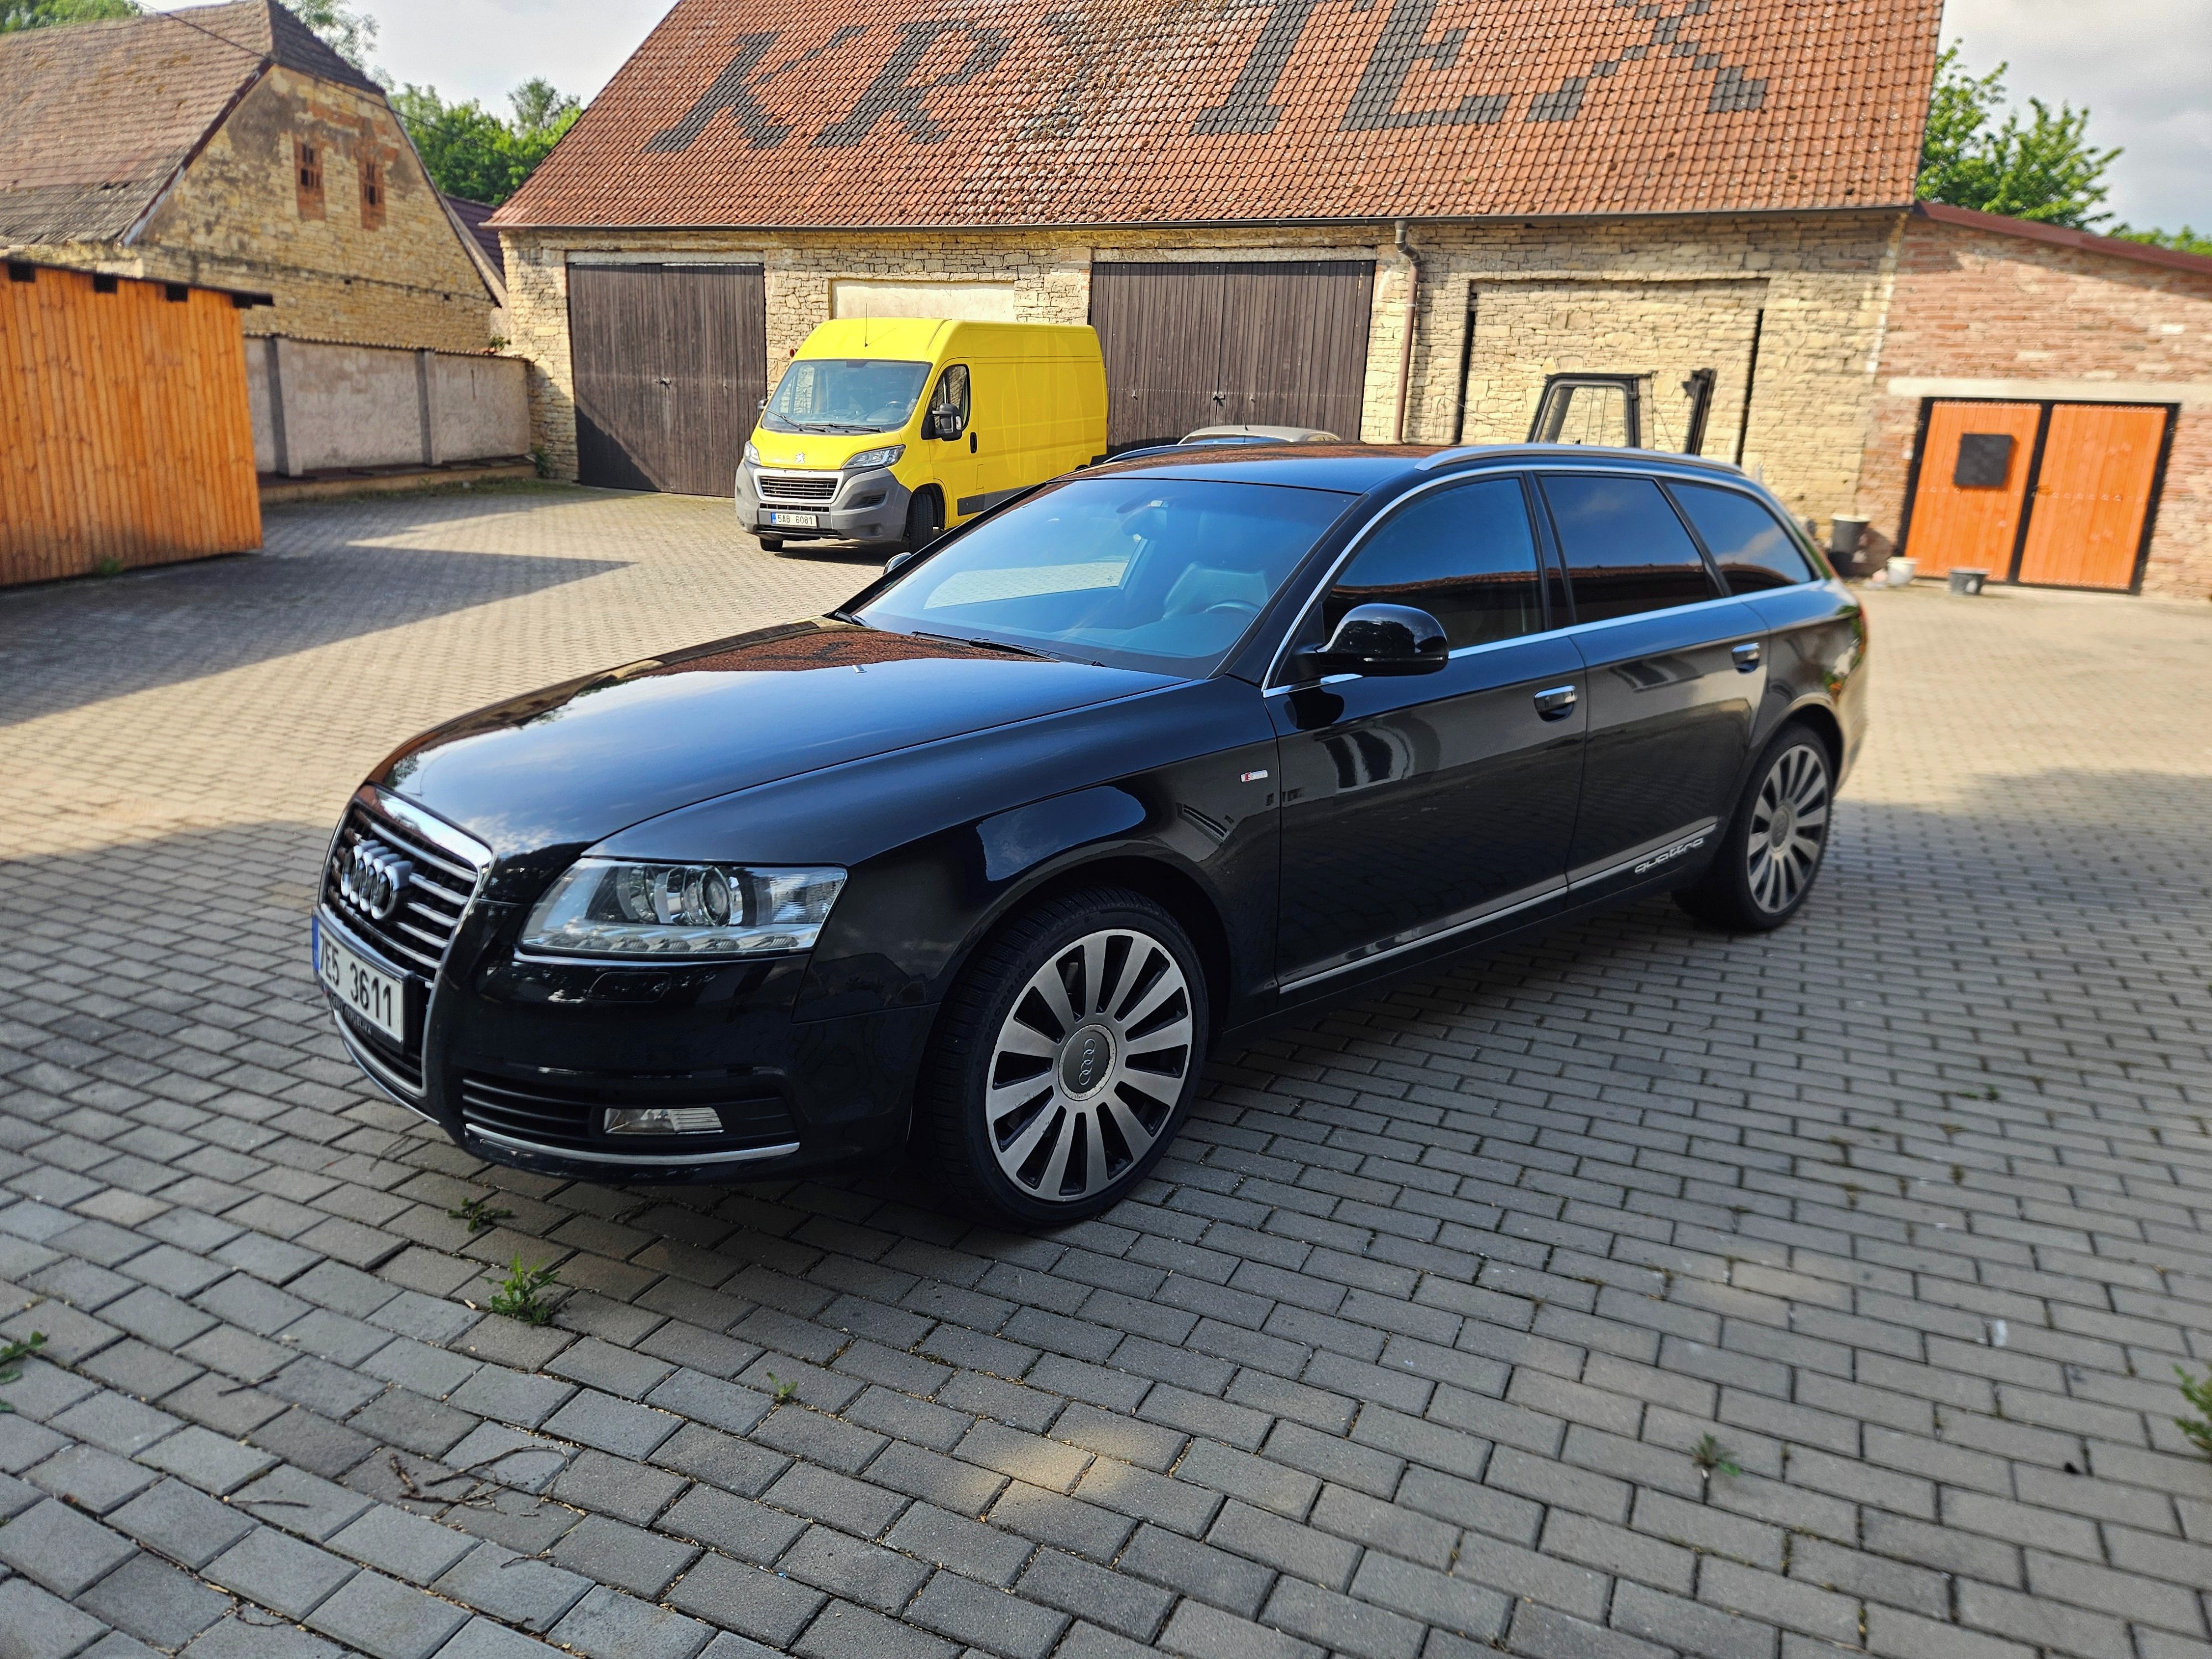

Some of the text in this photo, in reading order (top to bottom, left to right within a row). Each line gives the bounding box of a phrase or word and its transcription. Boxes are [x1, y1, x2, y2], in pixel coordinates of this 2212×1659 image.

[778, 514, 790, 523] 5AB
[795, 515, 813, 525] 6081
[1634, 837, 1704, 874] quattro
[320, 932, 340, 986] 7E5
[349, 961, 392, 1027] 3611
